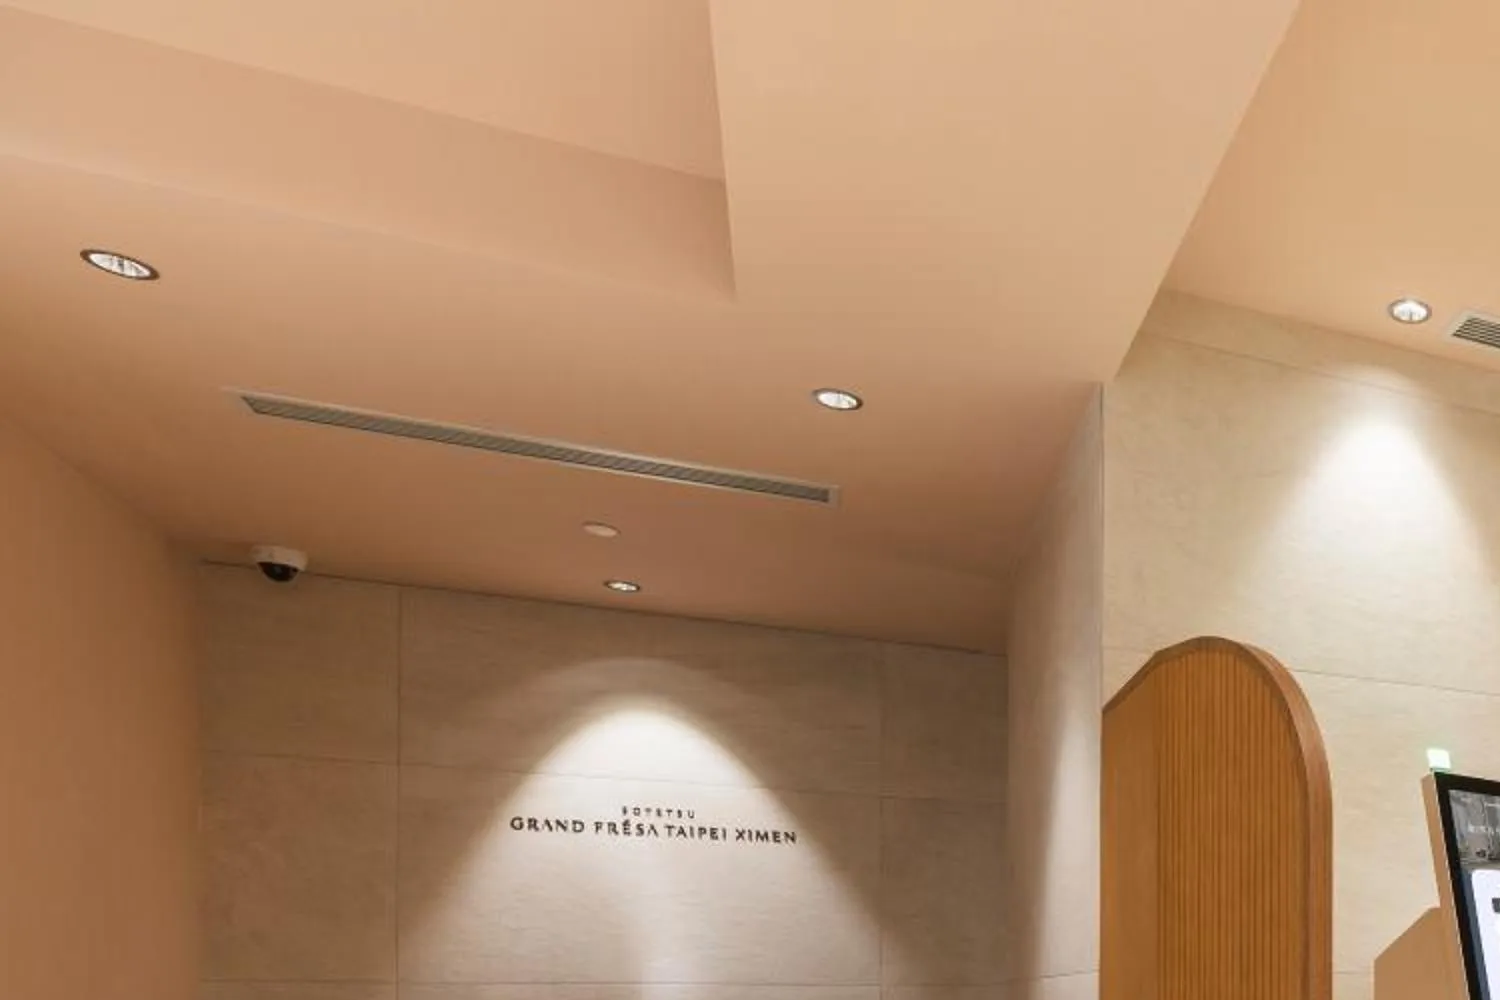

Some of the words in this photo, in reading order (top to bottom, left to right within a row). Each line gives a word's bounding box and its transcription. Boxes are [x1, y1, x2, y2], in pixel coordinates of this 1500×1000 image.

[510, 816, 586, 833] GRAND
[664, 824, 728, 842] TAIPEI
[735, 829, 798, 845] XIMEN
